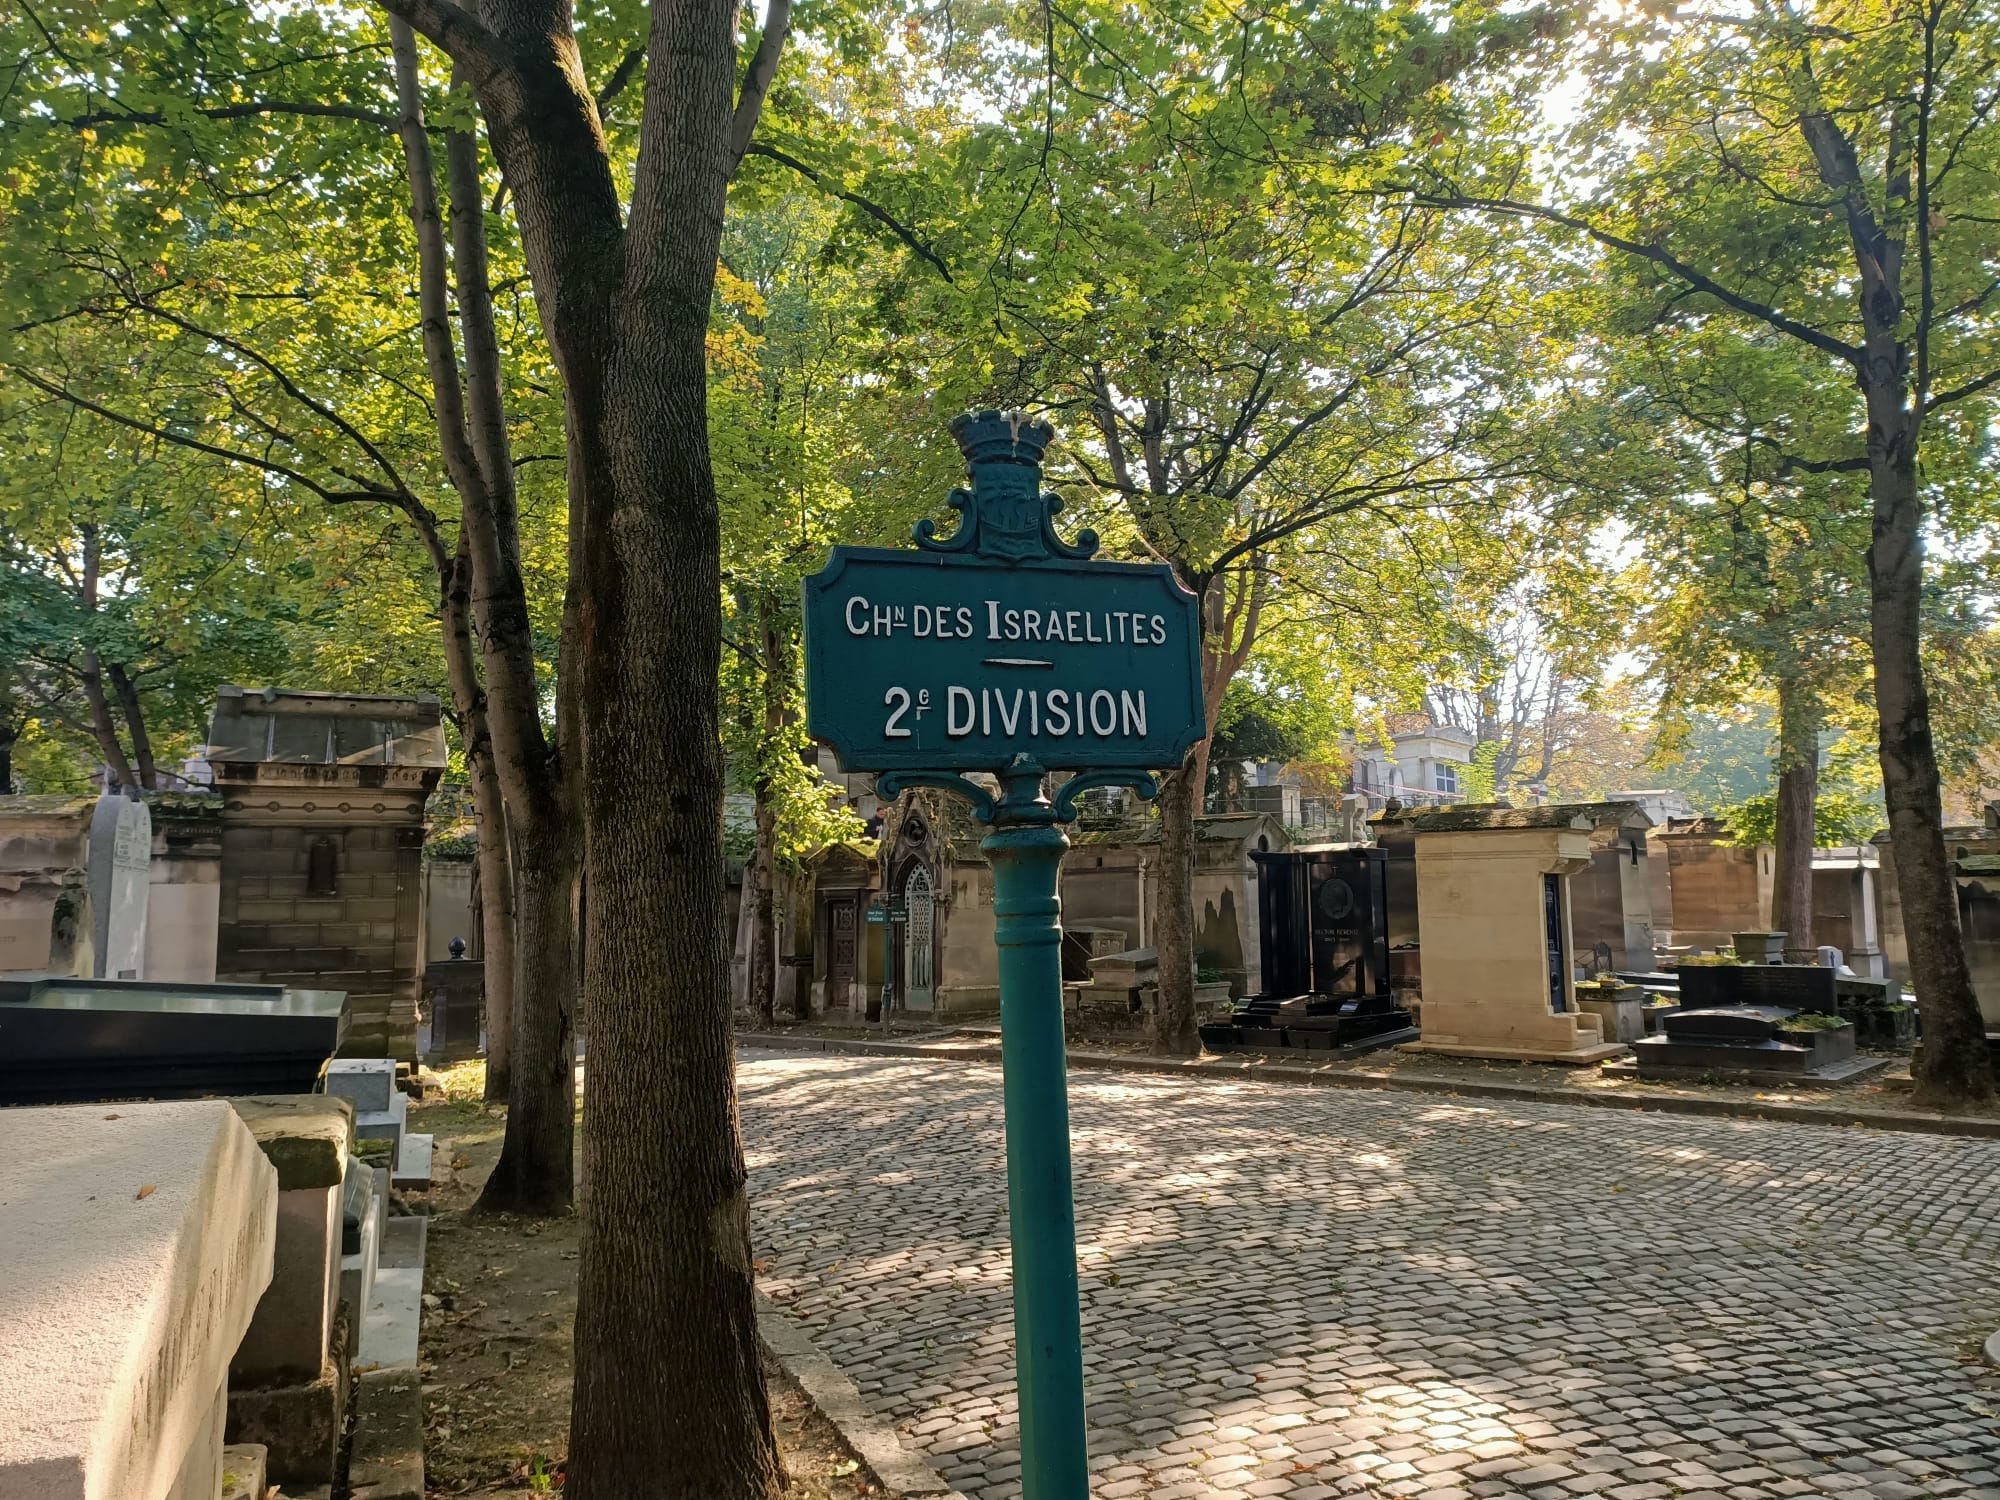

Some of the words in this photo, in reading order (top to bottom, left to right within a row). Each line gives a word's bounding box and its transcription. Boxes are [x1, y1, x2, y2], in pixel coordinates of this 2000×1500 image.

[913, 605, 973, 638] DES
[984, 600, 1167, 644] ISRAELITES
[947, 685, 1147, 736] DIVISION
